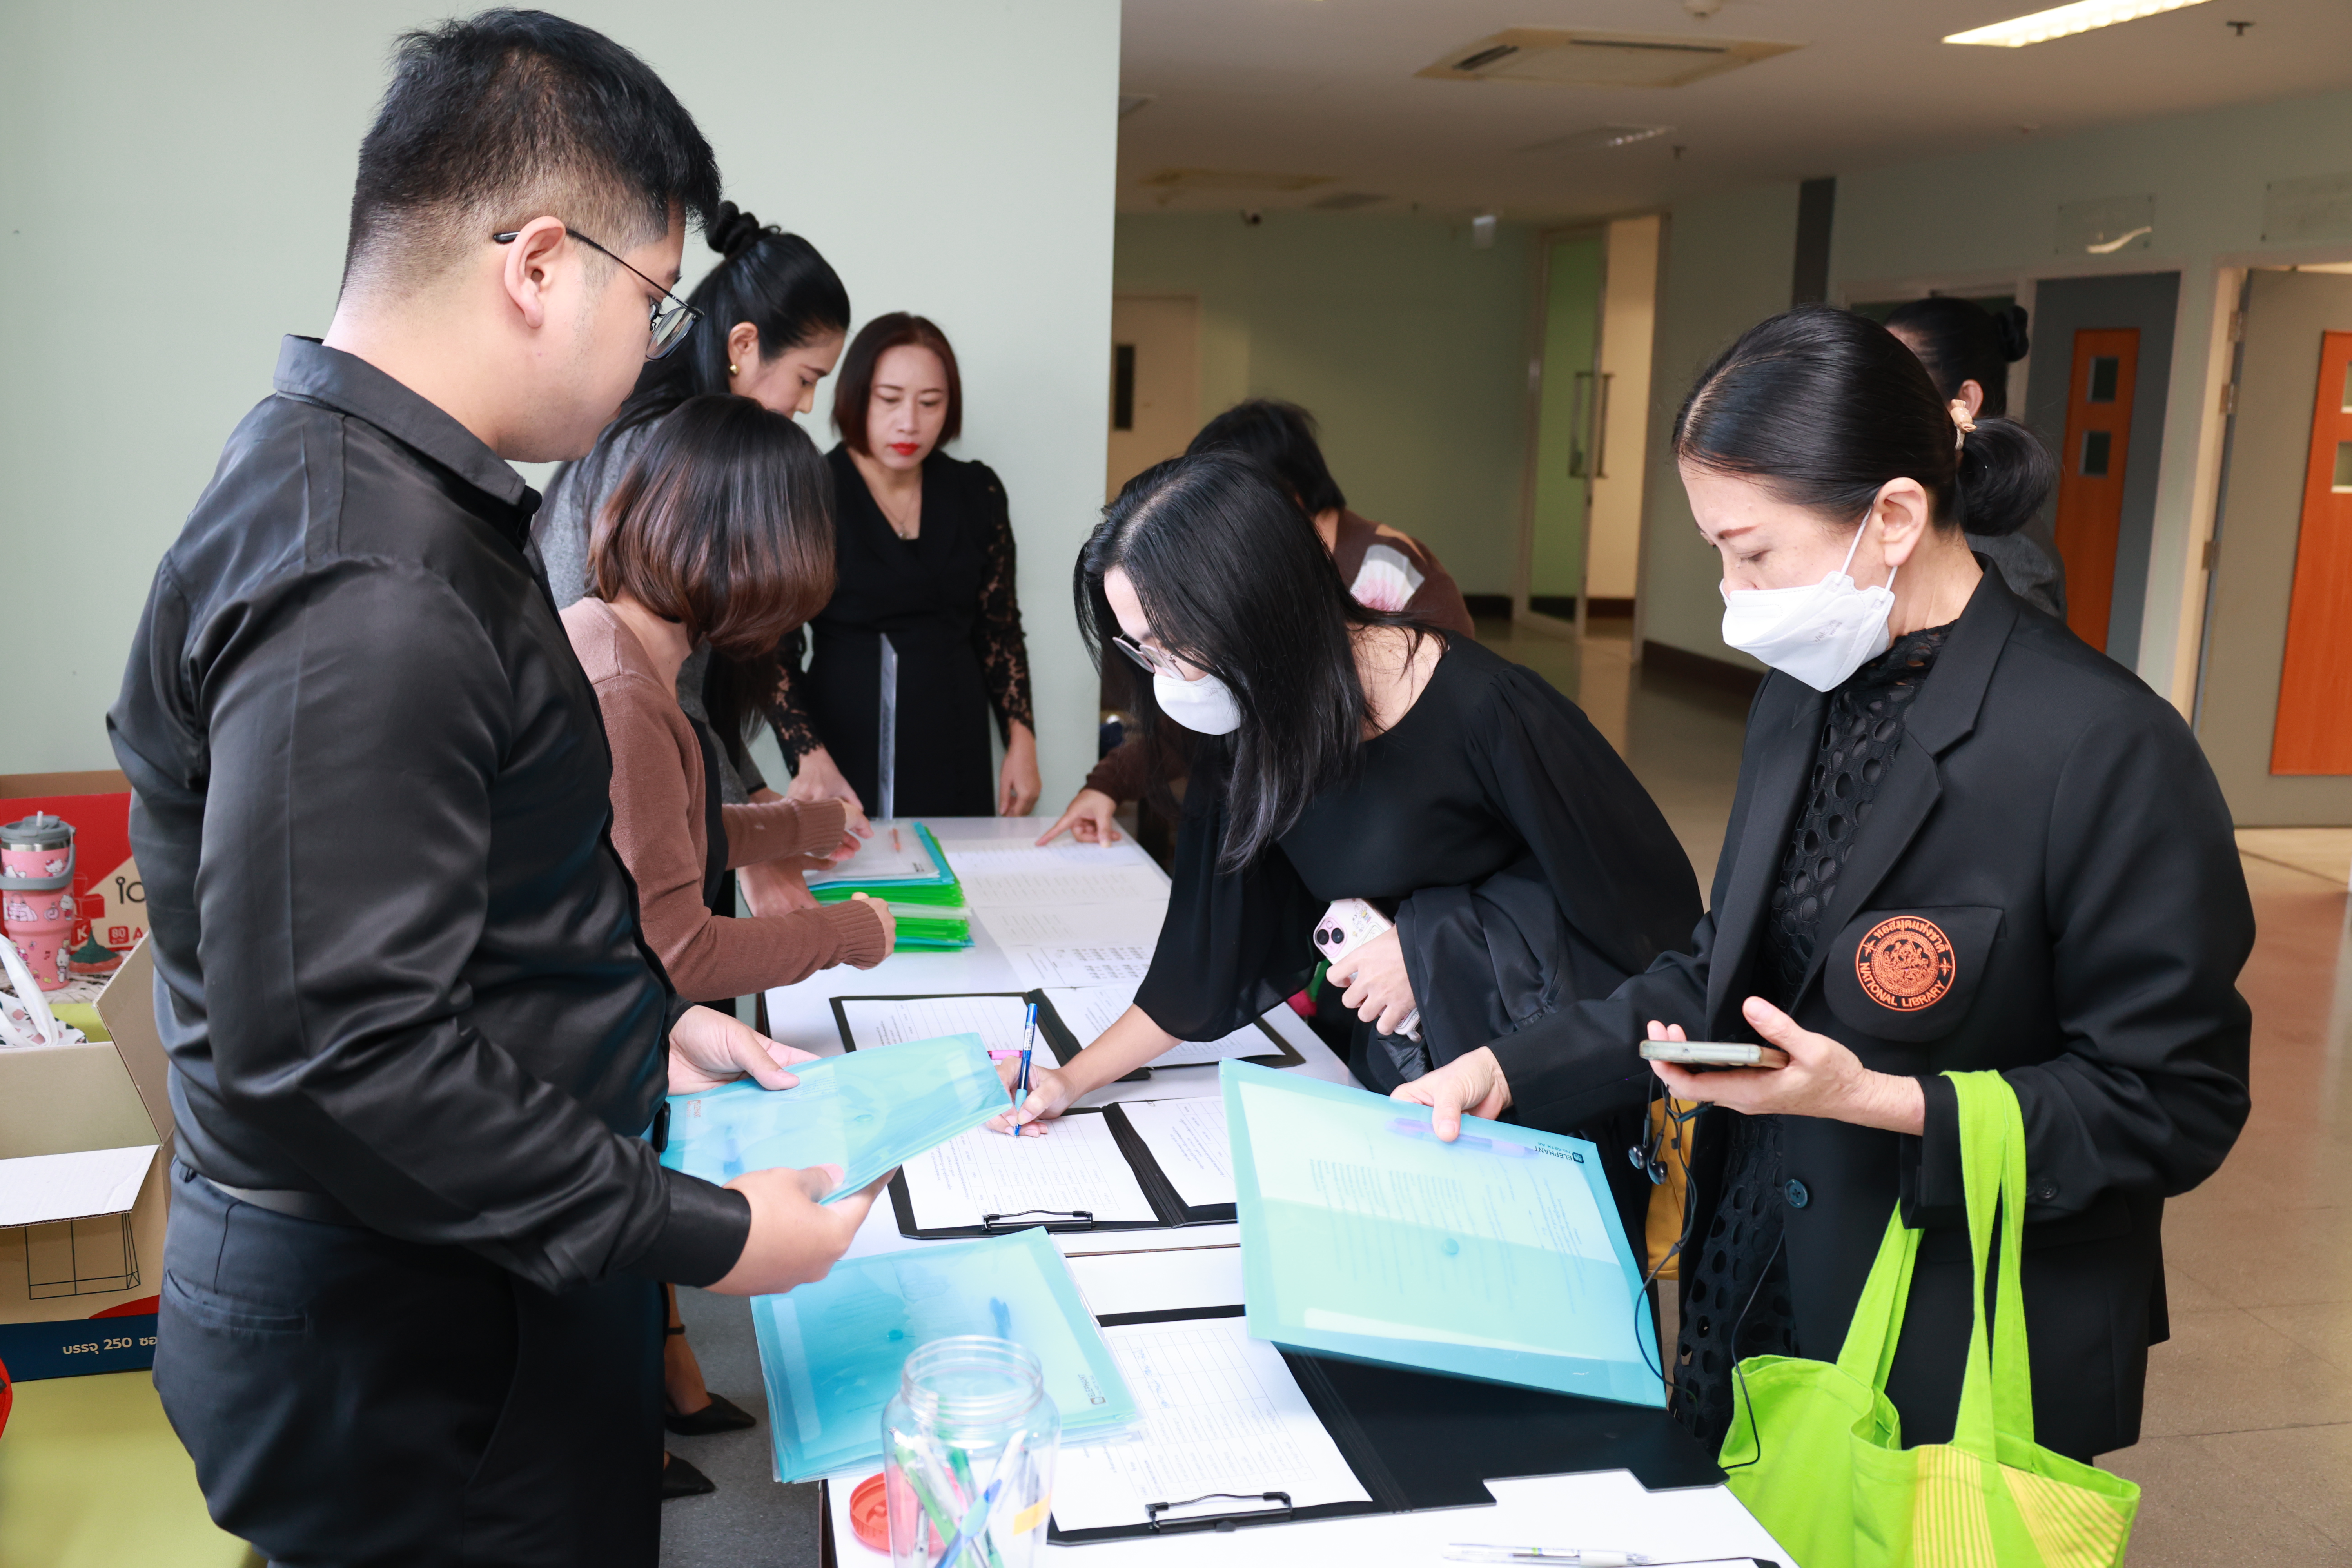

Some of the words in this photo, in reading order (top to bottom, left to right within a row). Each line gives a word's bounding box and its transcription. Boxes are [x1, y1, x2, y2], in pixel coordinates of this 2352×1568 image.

[111, 928, 126, 938] 80
[1873, 919, 1949, 953] หอสมุดแห่งชาติ
[1860, 962, 1898, 1006] NATIONAL
[1902, 980, 1945, 1007] LIBRARY
[1534, 1145, 1573, 1161] ELEPHANT
[62, 1343, 99, 1355] บรรจุ
[103, 1337, 132, 1350] 250
[1078, 1374, 1096, 1398] ELEPHANT
